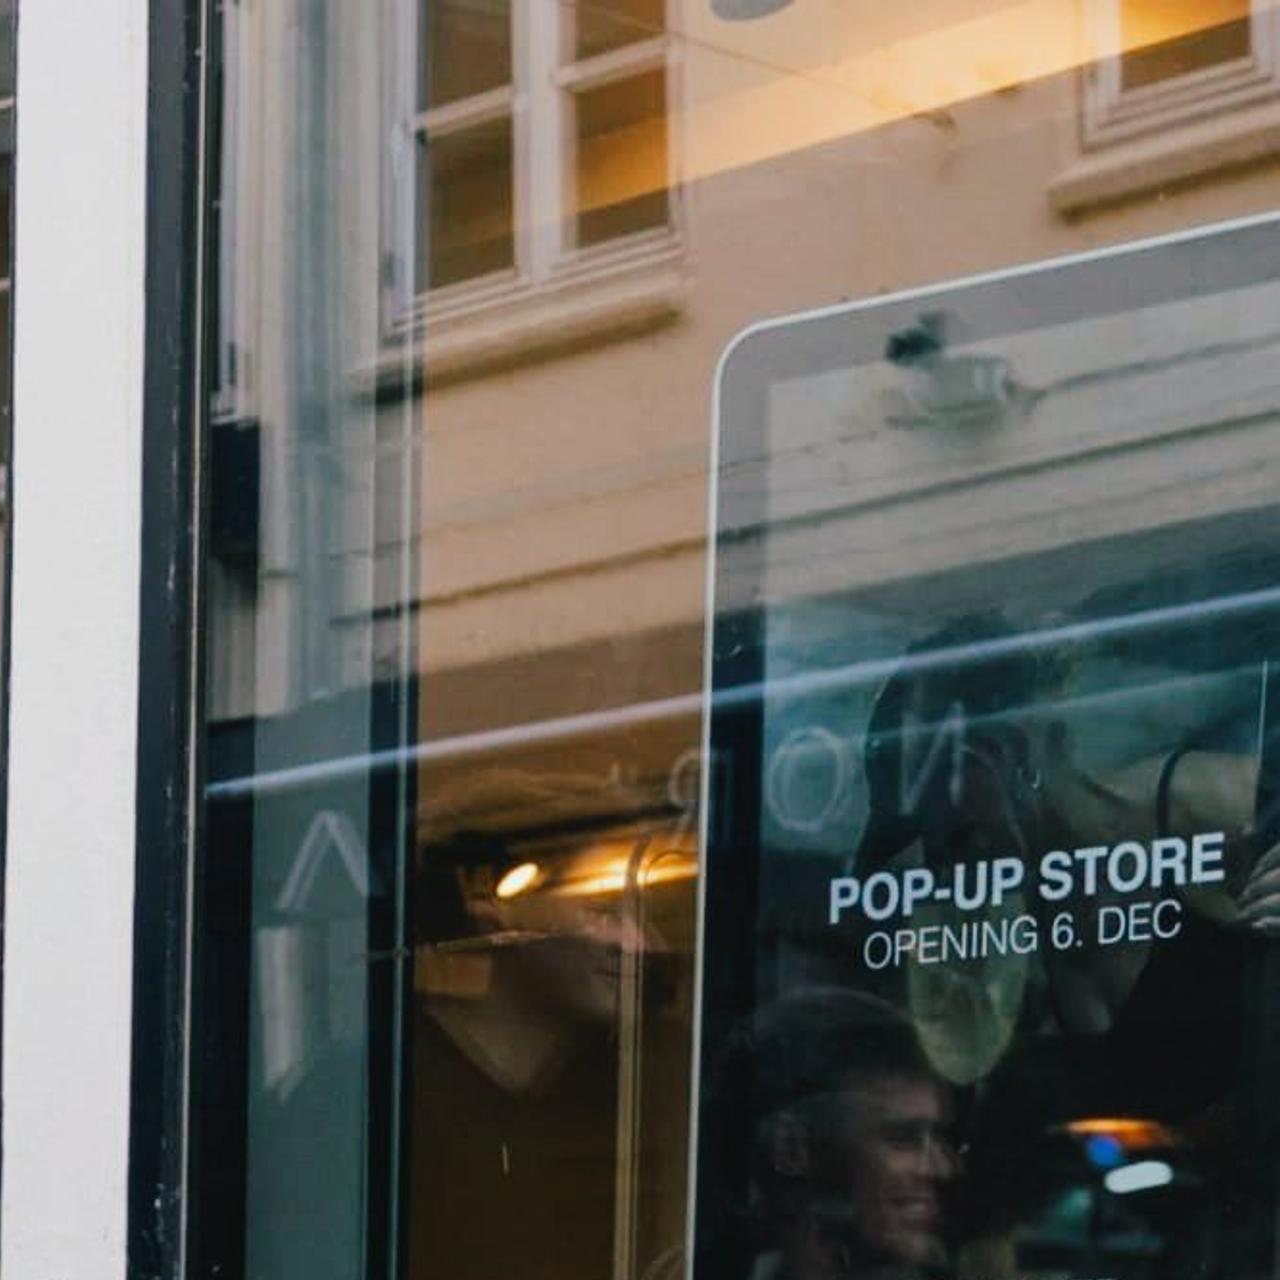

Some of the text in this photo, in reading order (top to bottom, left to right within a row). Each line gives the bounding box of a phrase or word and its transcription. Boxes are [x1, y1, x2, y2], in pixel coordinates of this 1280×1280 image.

[828, 832, 1225, 924] POP-UP STORE
[863, 900, 1182, 969] OPENING 6. DEC
